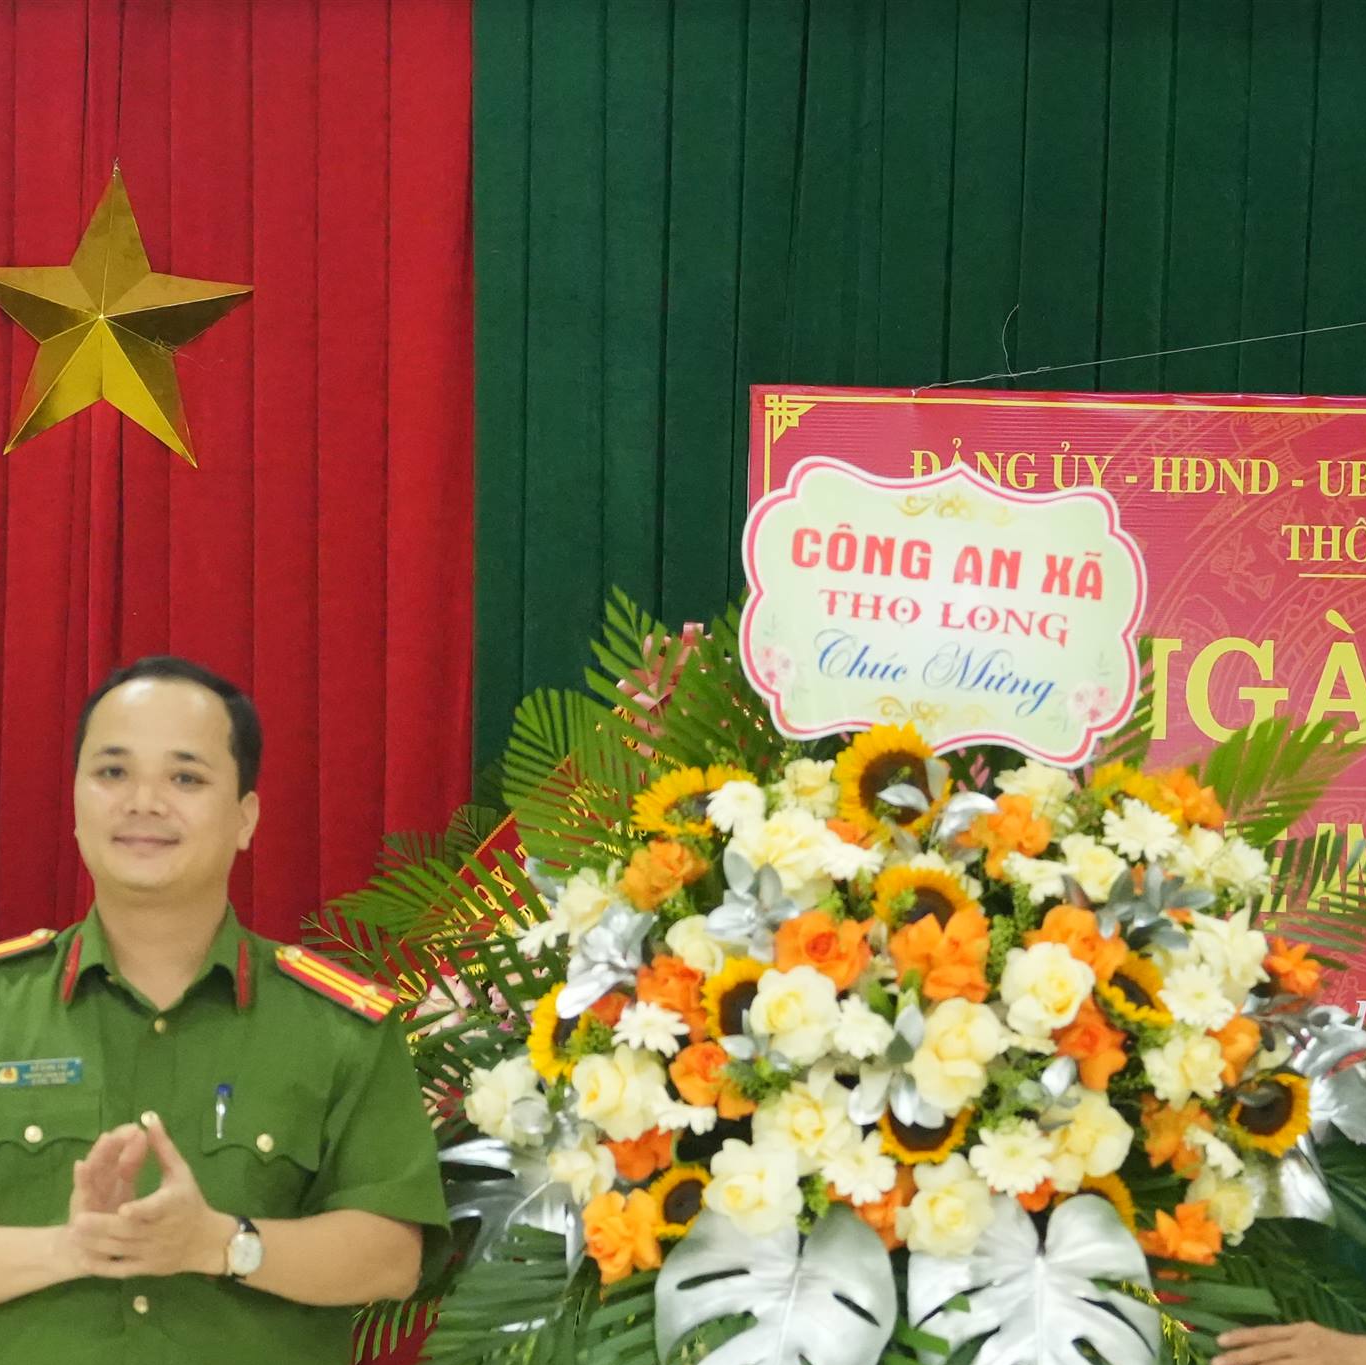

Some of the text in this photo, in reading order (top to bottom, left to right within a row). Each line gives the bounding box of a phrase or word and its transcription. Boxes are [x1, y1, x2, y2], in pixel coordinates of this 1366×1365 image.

[1051, 441, 1114, 489] ỦY
[1150, 456, 1279, 495] HĐND
[790, 523, 1104, 601] CÔNG AN XÃ
[818, 589, 1070, 648] THỌ LONG
[814, 628, 1055, 717] Chúc Mừng
